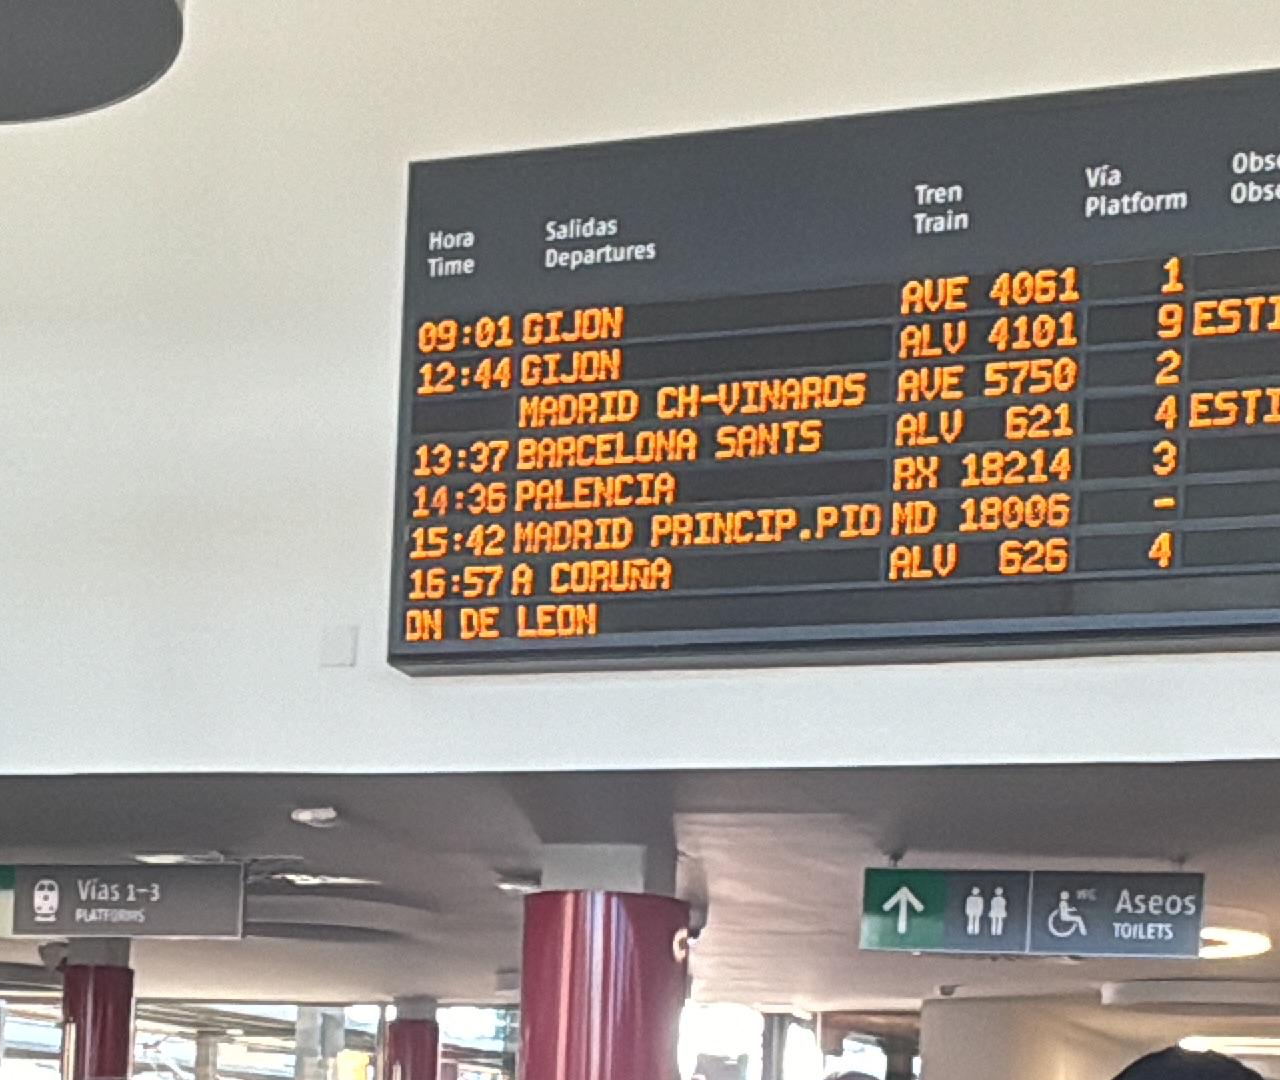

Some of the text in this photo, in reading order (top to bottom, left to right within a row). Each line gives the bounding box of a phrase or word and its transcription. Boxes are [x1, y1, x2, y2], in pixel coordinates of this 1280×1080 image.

[1085, 164, 1121, 188] Vía
[915, 184, 962, 205] Tren
[1085, 190, 1187, 217] Platform
[545, 217, 618, 241] Salidas
[914, 209, 969, 233] Train
[428, 229, 475, 252] Hora
[427, 256, 475, 277] Time
[545, 242, 656, 270] Departures
[418, 257, 1184, 353] 09:01 GIJON AVE 4061 1
[417, 356, 512, 395] 12:44
[520, 348, 622, 387] GIJON
[899, 320, 967, 359] ALV
[988, 311, 1078, 352] 4101
[1158, 303, 1184, 339] 9
[518, 350, 1182, 428] MADRID CH-VINAROS AVE 5750 2
[414, 440, 510, 476] 13:37
[516, 427, 698, 471] BARCELONA
[715, 419, 823, 460] SANTS
[895, 409, 963, 447] ALV
[1005, 403, 1074, 440] 621
[1155, 395, 1178, 430] 4
[412, 482, 508, 518] 14:36
[514, 472, 676, 512] PALENCIA
[960, 447, 1072, 488] 18214
[1153, 440, 1177, 476] 3
[410, 524, 506, 560] 15:42
[512, 516, 634, 554] MADRID
[650, 504, 882, 548] PRINCIP.PIO
[890, 500, 937, 536] MD
[959, 492, 1071, 532] 18006
[409, 532, 1172, 600] 16:57 A CORUÑA ALV 626 4
[460, 606, 500, 640] DE
[517, 602, 598, 638] LEON
[77, 878, 161, 902] Vías 1-3
[1115, 888, 1196, 917] Aseos
[1113, 922, 1174, 941] TOILETS
